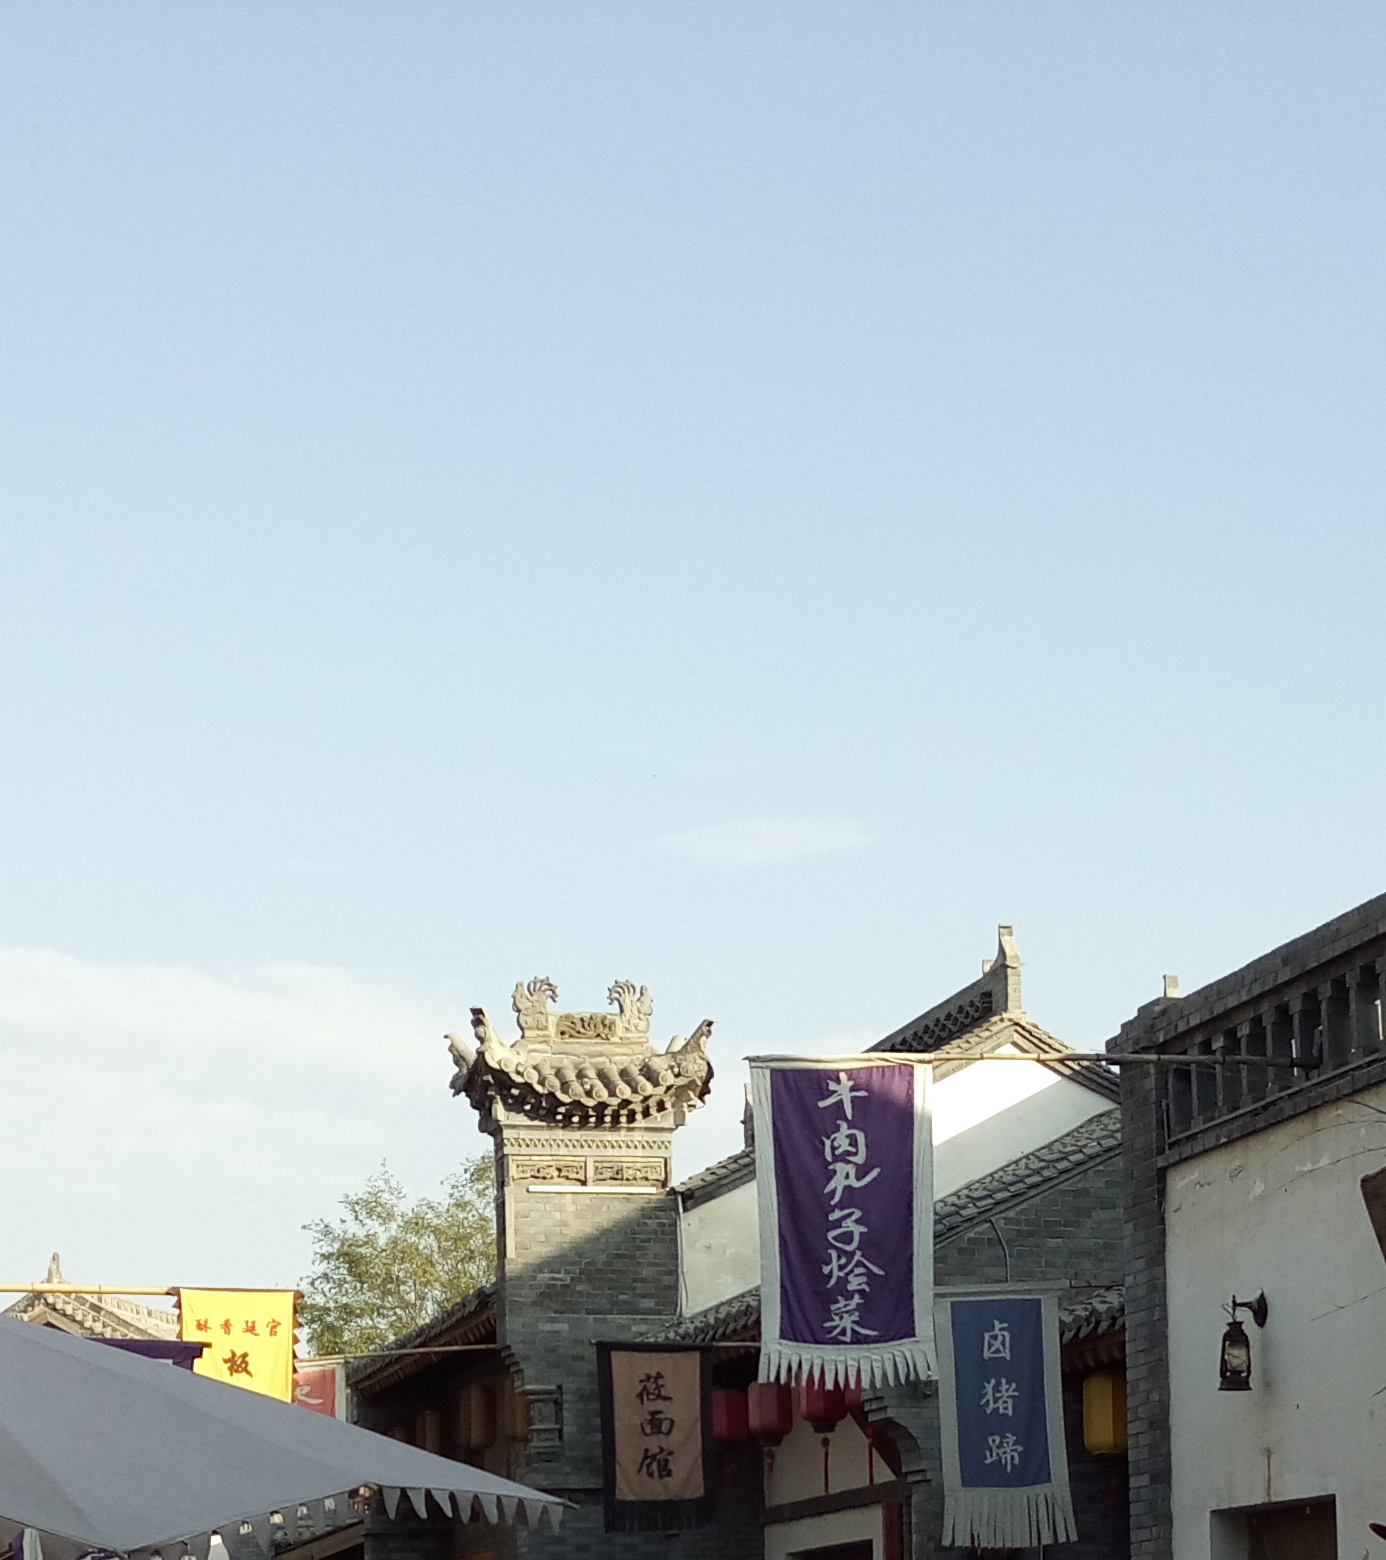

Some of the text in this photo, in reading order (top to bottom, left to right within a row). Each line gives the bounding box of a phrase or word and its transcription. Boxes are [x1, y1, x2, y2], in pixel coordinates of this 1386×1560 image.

[636, 1372, 674, 1480] 莜面馆
[979, 1319, 1024, 1474] 卤猪蹄
